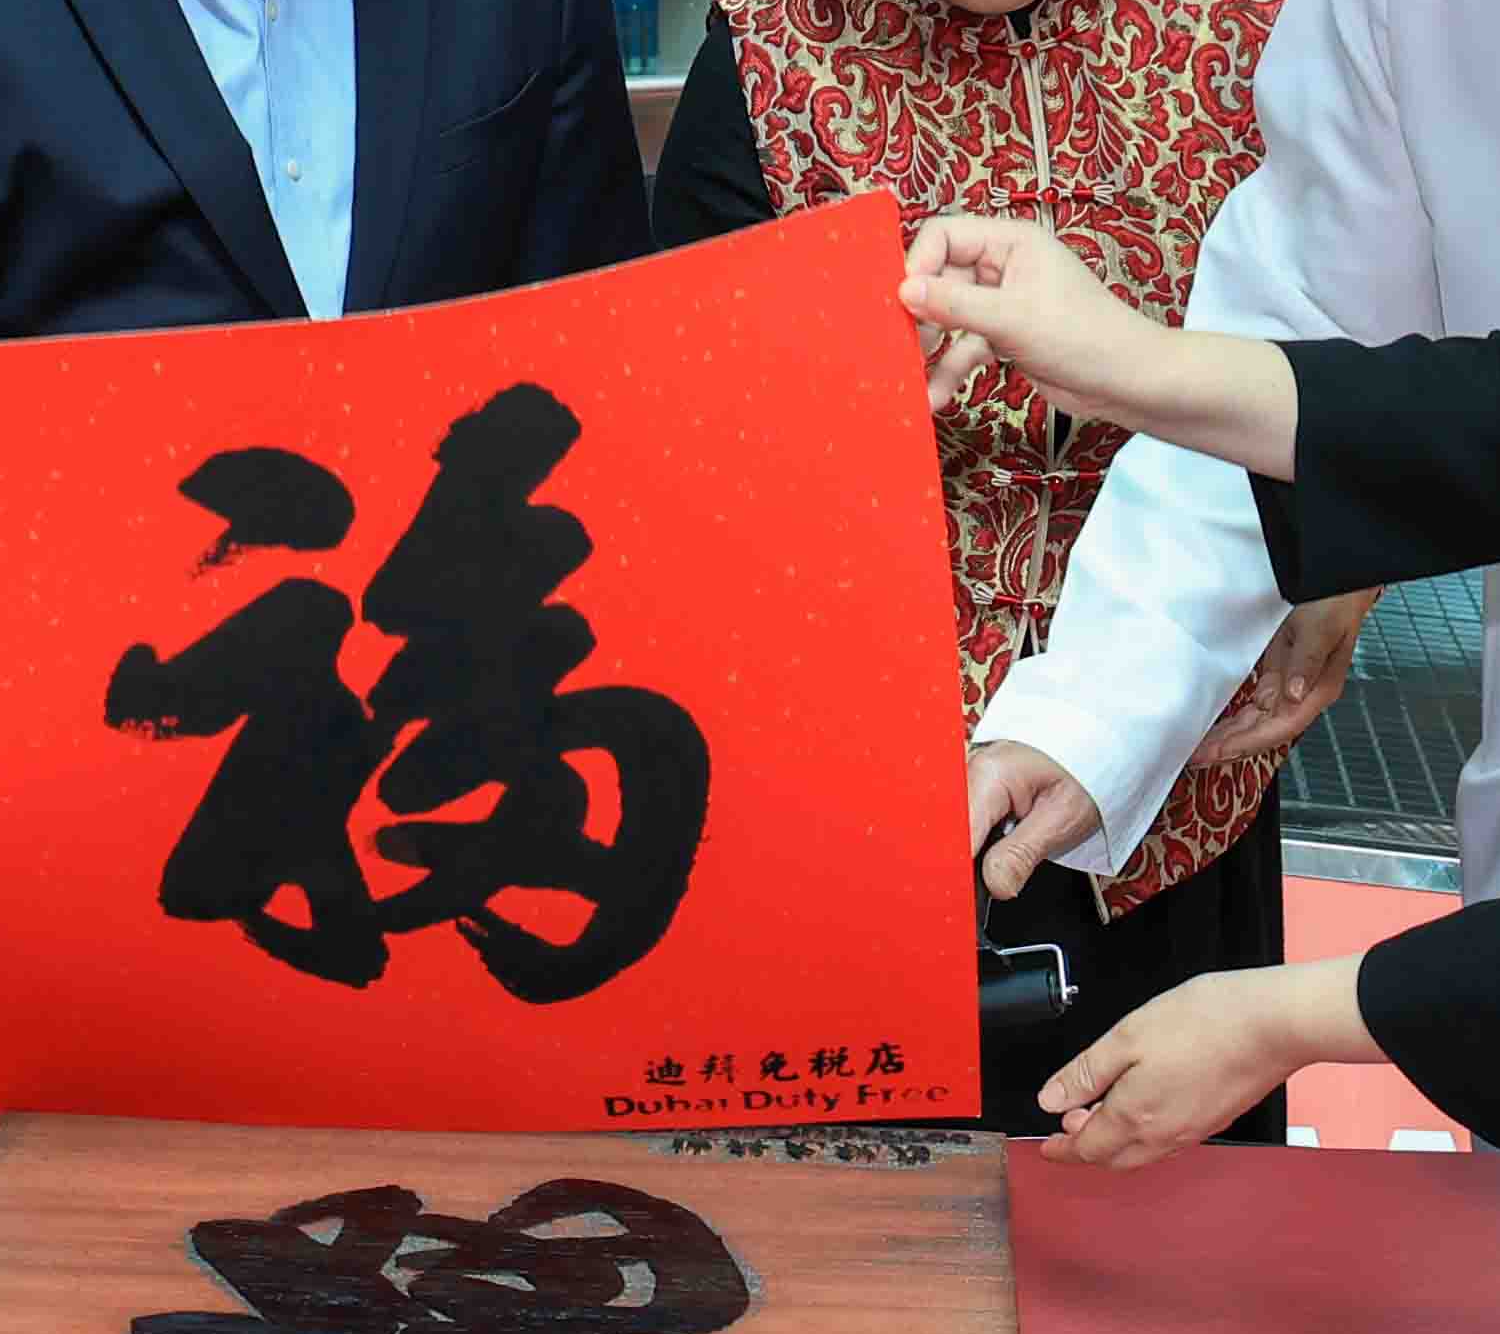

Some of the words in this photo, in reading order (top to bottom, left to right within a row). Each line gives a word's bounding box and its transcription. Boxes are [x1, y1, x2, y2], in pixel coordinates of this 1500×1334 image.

[103, 382, 712, 1005] 福
[742, 1088, 841, 1113] Duty
[856, 1083, 951, 1106] Free
